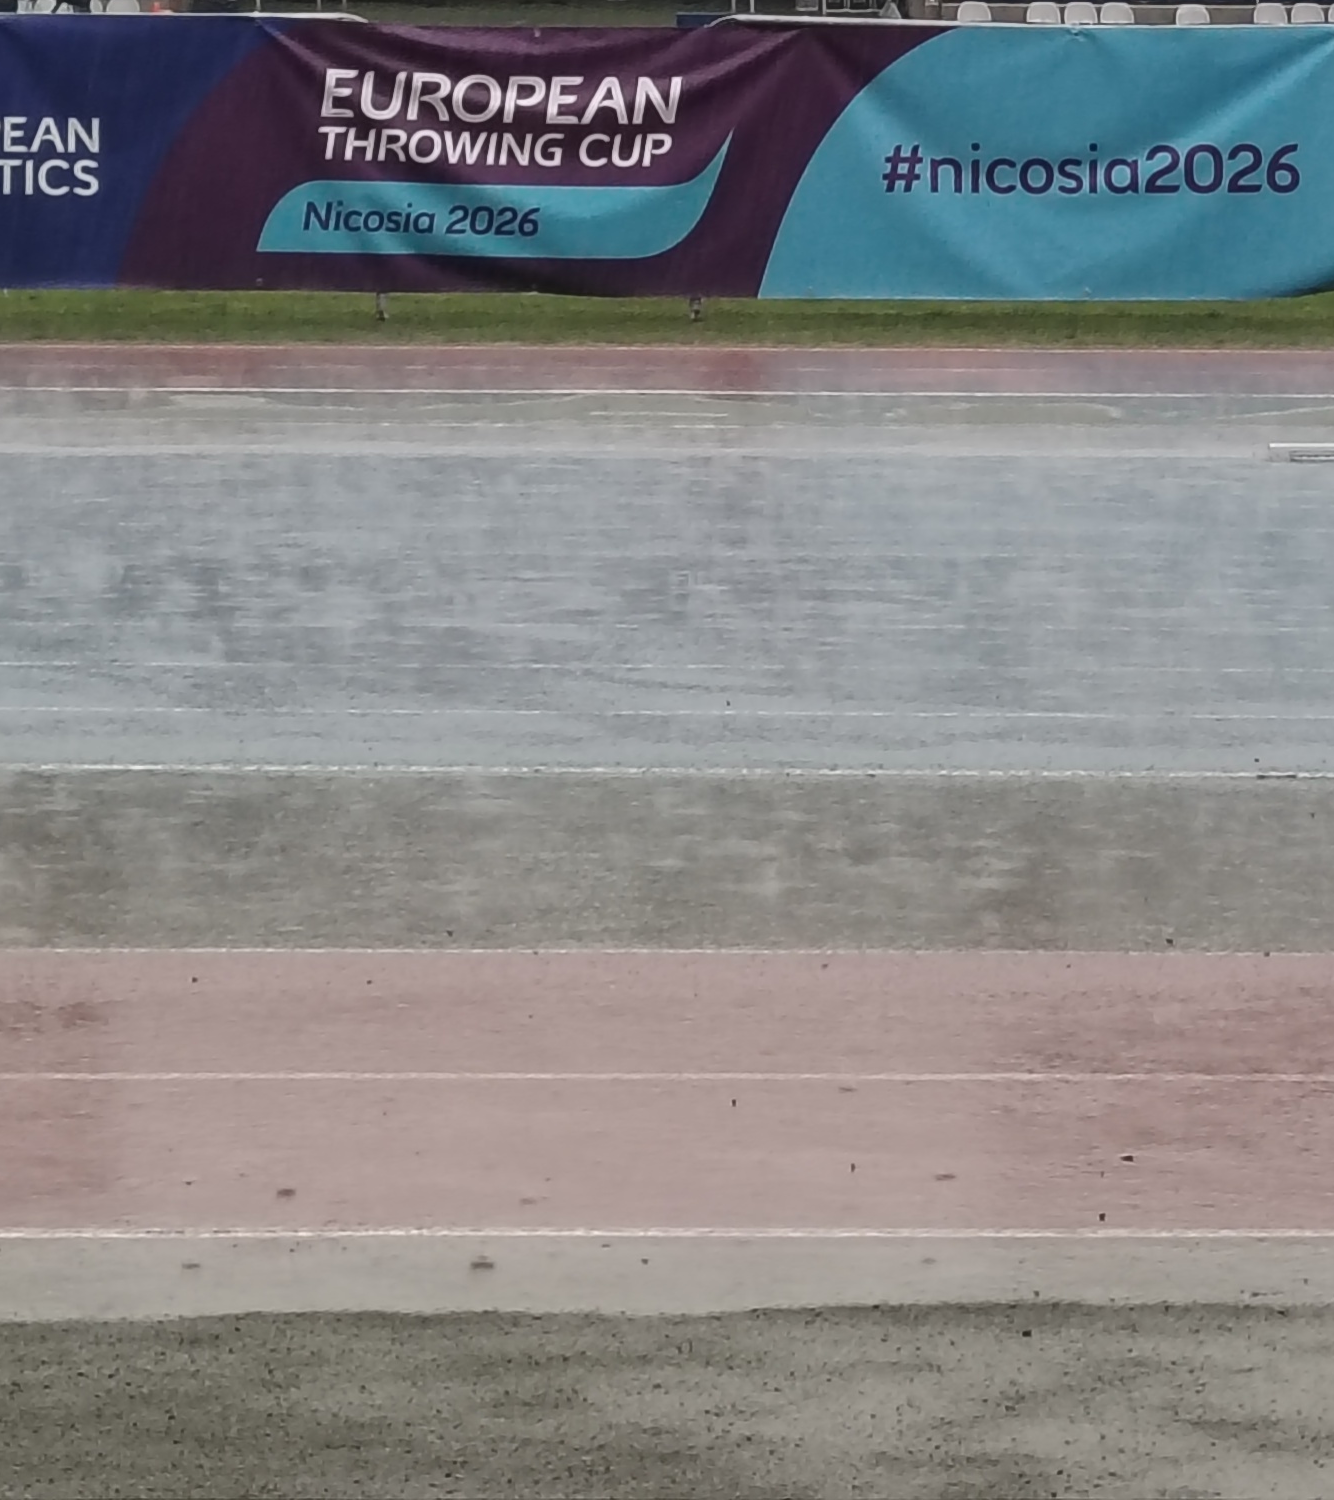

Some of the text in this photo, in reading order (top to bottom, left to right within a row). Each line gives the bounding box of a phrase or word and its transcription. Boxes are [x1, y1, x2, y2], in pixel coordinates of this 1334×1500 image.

[320, 68, 683, 125] EUROPEAN
[318, 126, 673, 168] THROWING CUP
[882, 143, 1301, 194] #nicosia2026
[303, 201, 540, 237] Nicosia 2026
